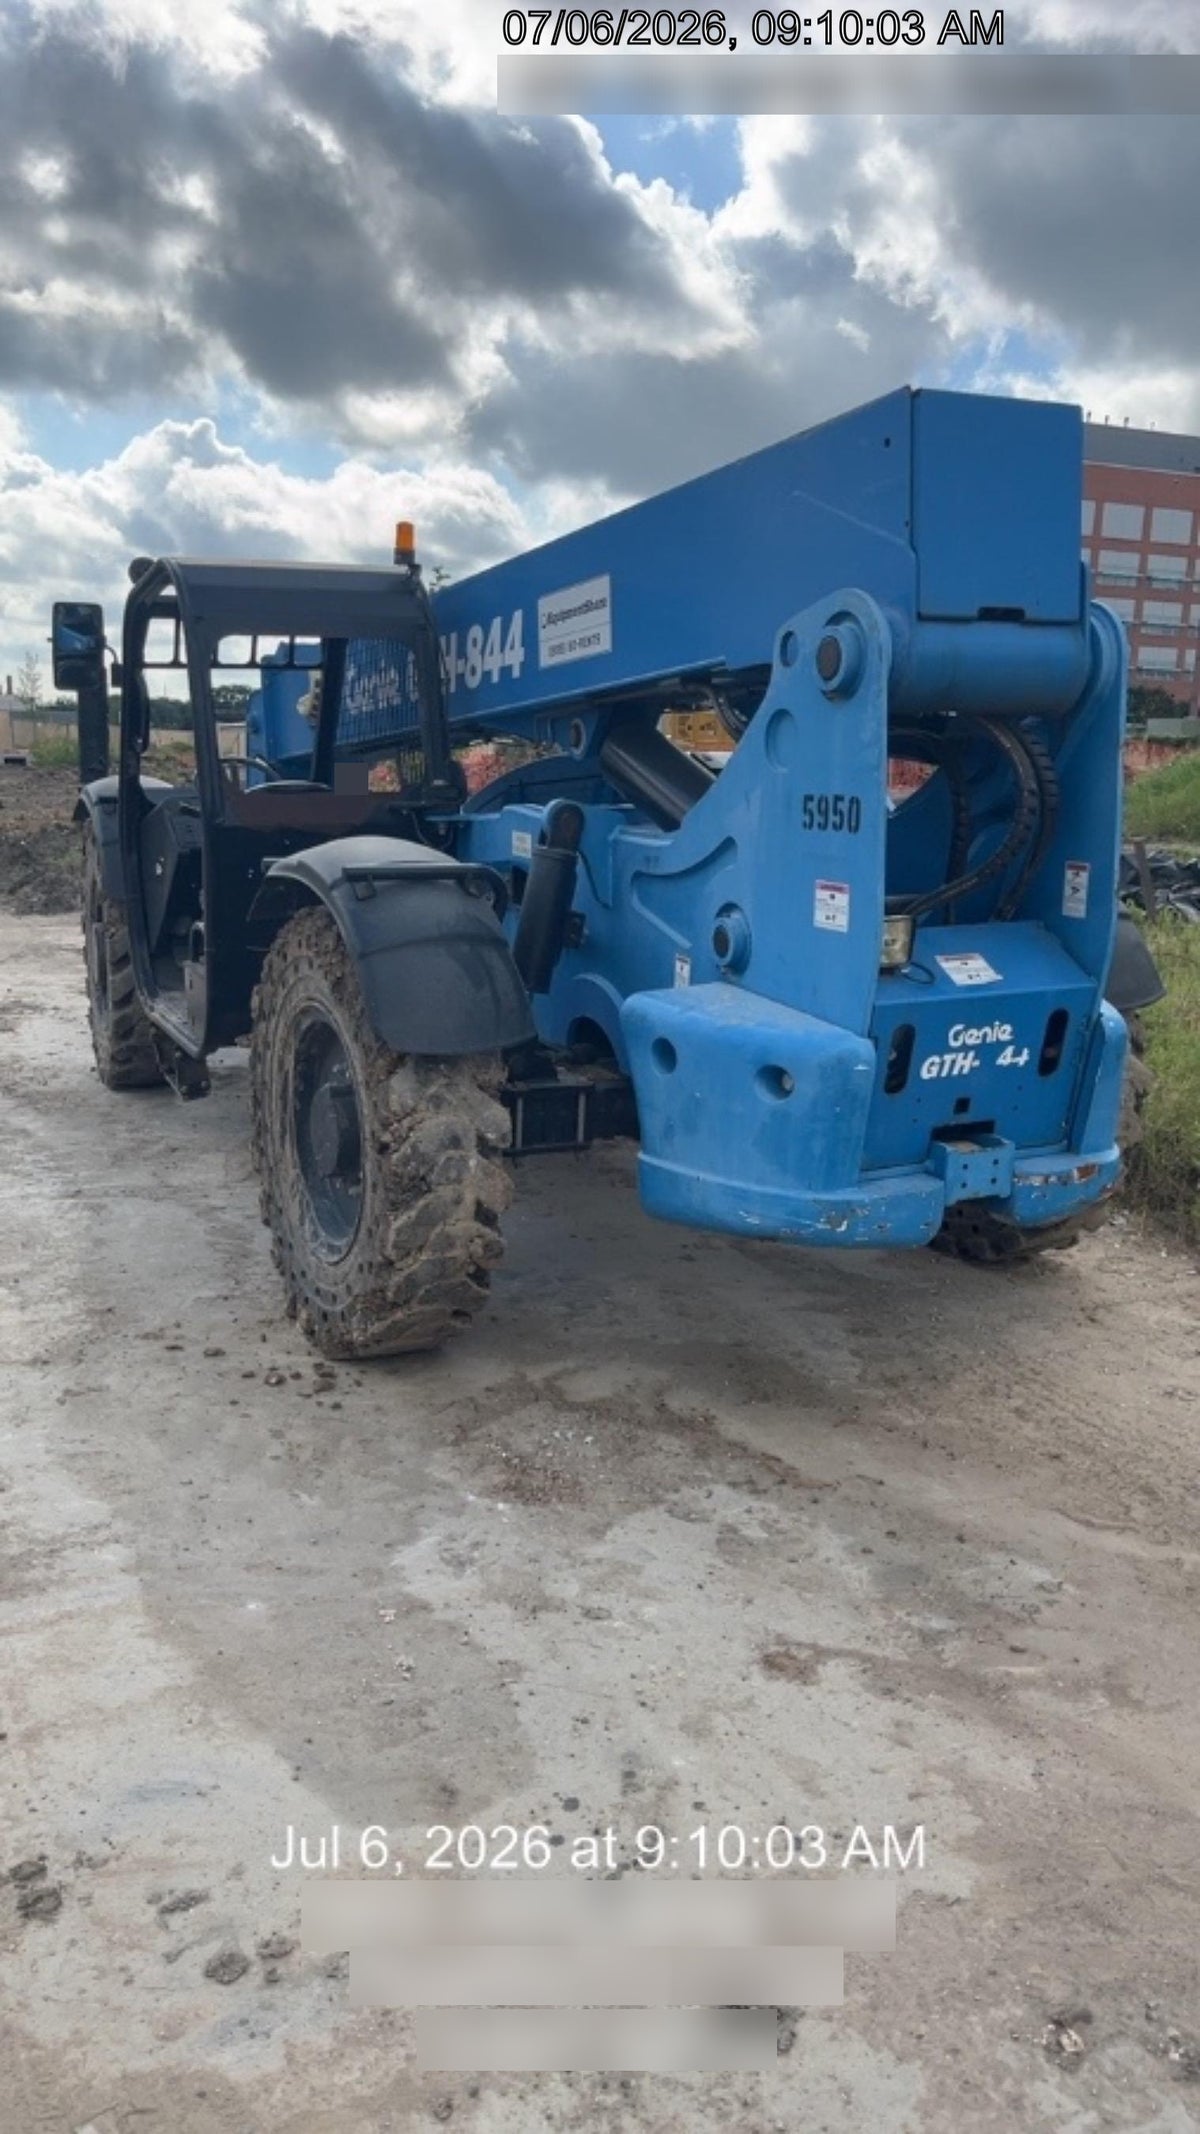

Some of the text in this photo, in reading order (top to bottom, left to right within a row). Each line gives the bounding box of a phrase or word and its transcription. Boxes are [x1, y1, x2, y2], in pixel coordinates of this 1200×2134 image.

[803, 793, 861, 834] 5950
[948, 1020, 1015, 1048] Genie
[920, 1050, 981, 1080] GTH-
